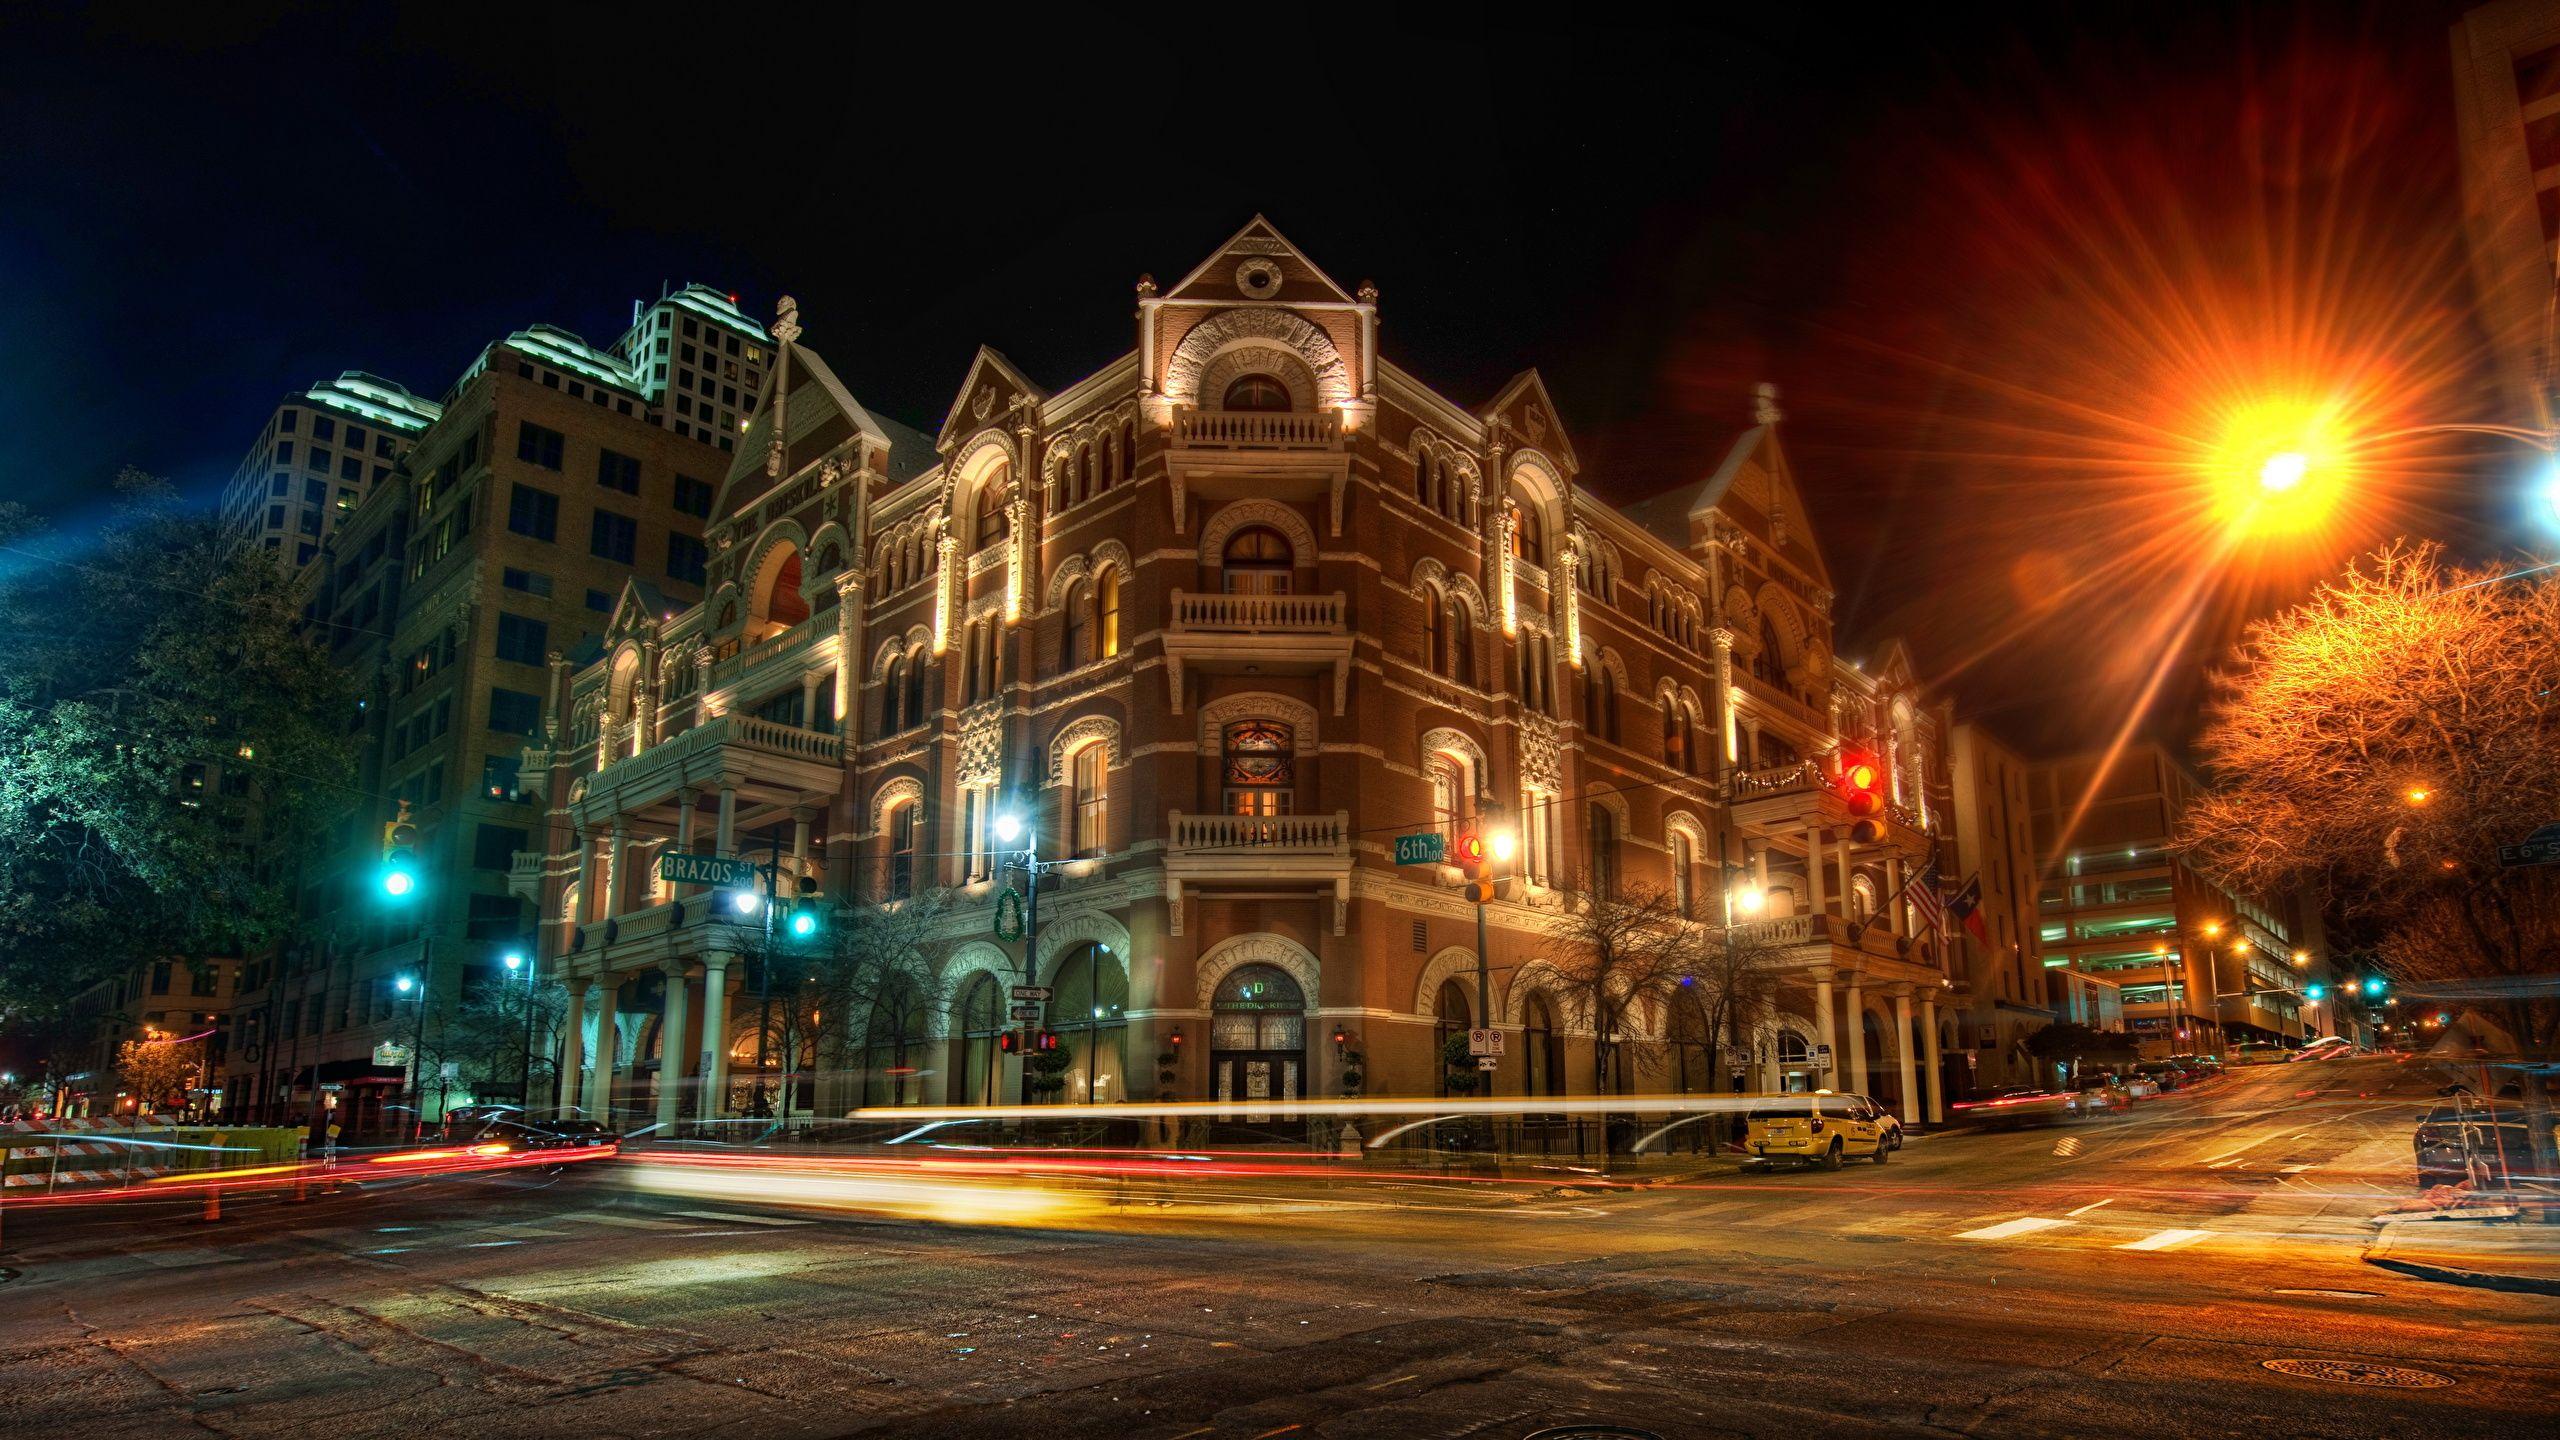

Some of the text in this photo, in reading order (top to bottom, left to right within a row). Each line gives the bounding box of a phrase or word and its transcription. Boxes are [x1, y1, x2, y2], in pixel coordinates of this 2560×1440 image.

[1401, 839, 1428, 860] 6th
[1428, 850, 1443, 861] 100
[2502, 847, 2517, 860] E
[664, 856, 752, 883] BRAZOS ST
[733, 876, 753, 888] 600
